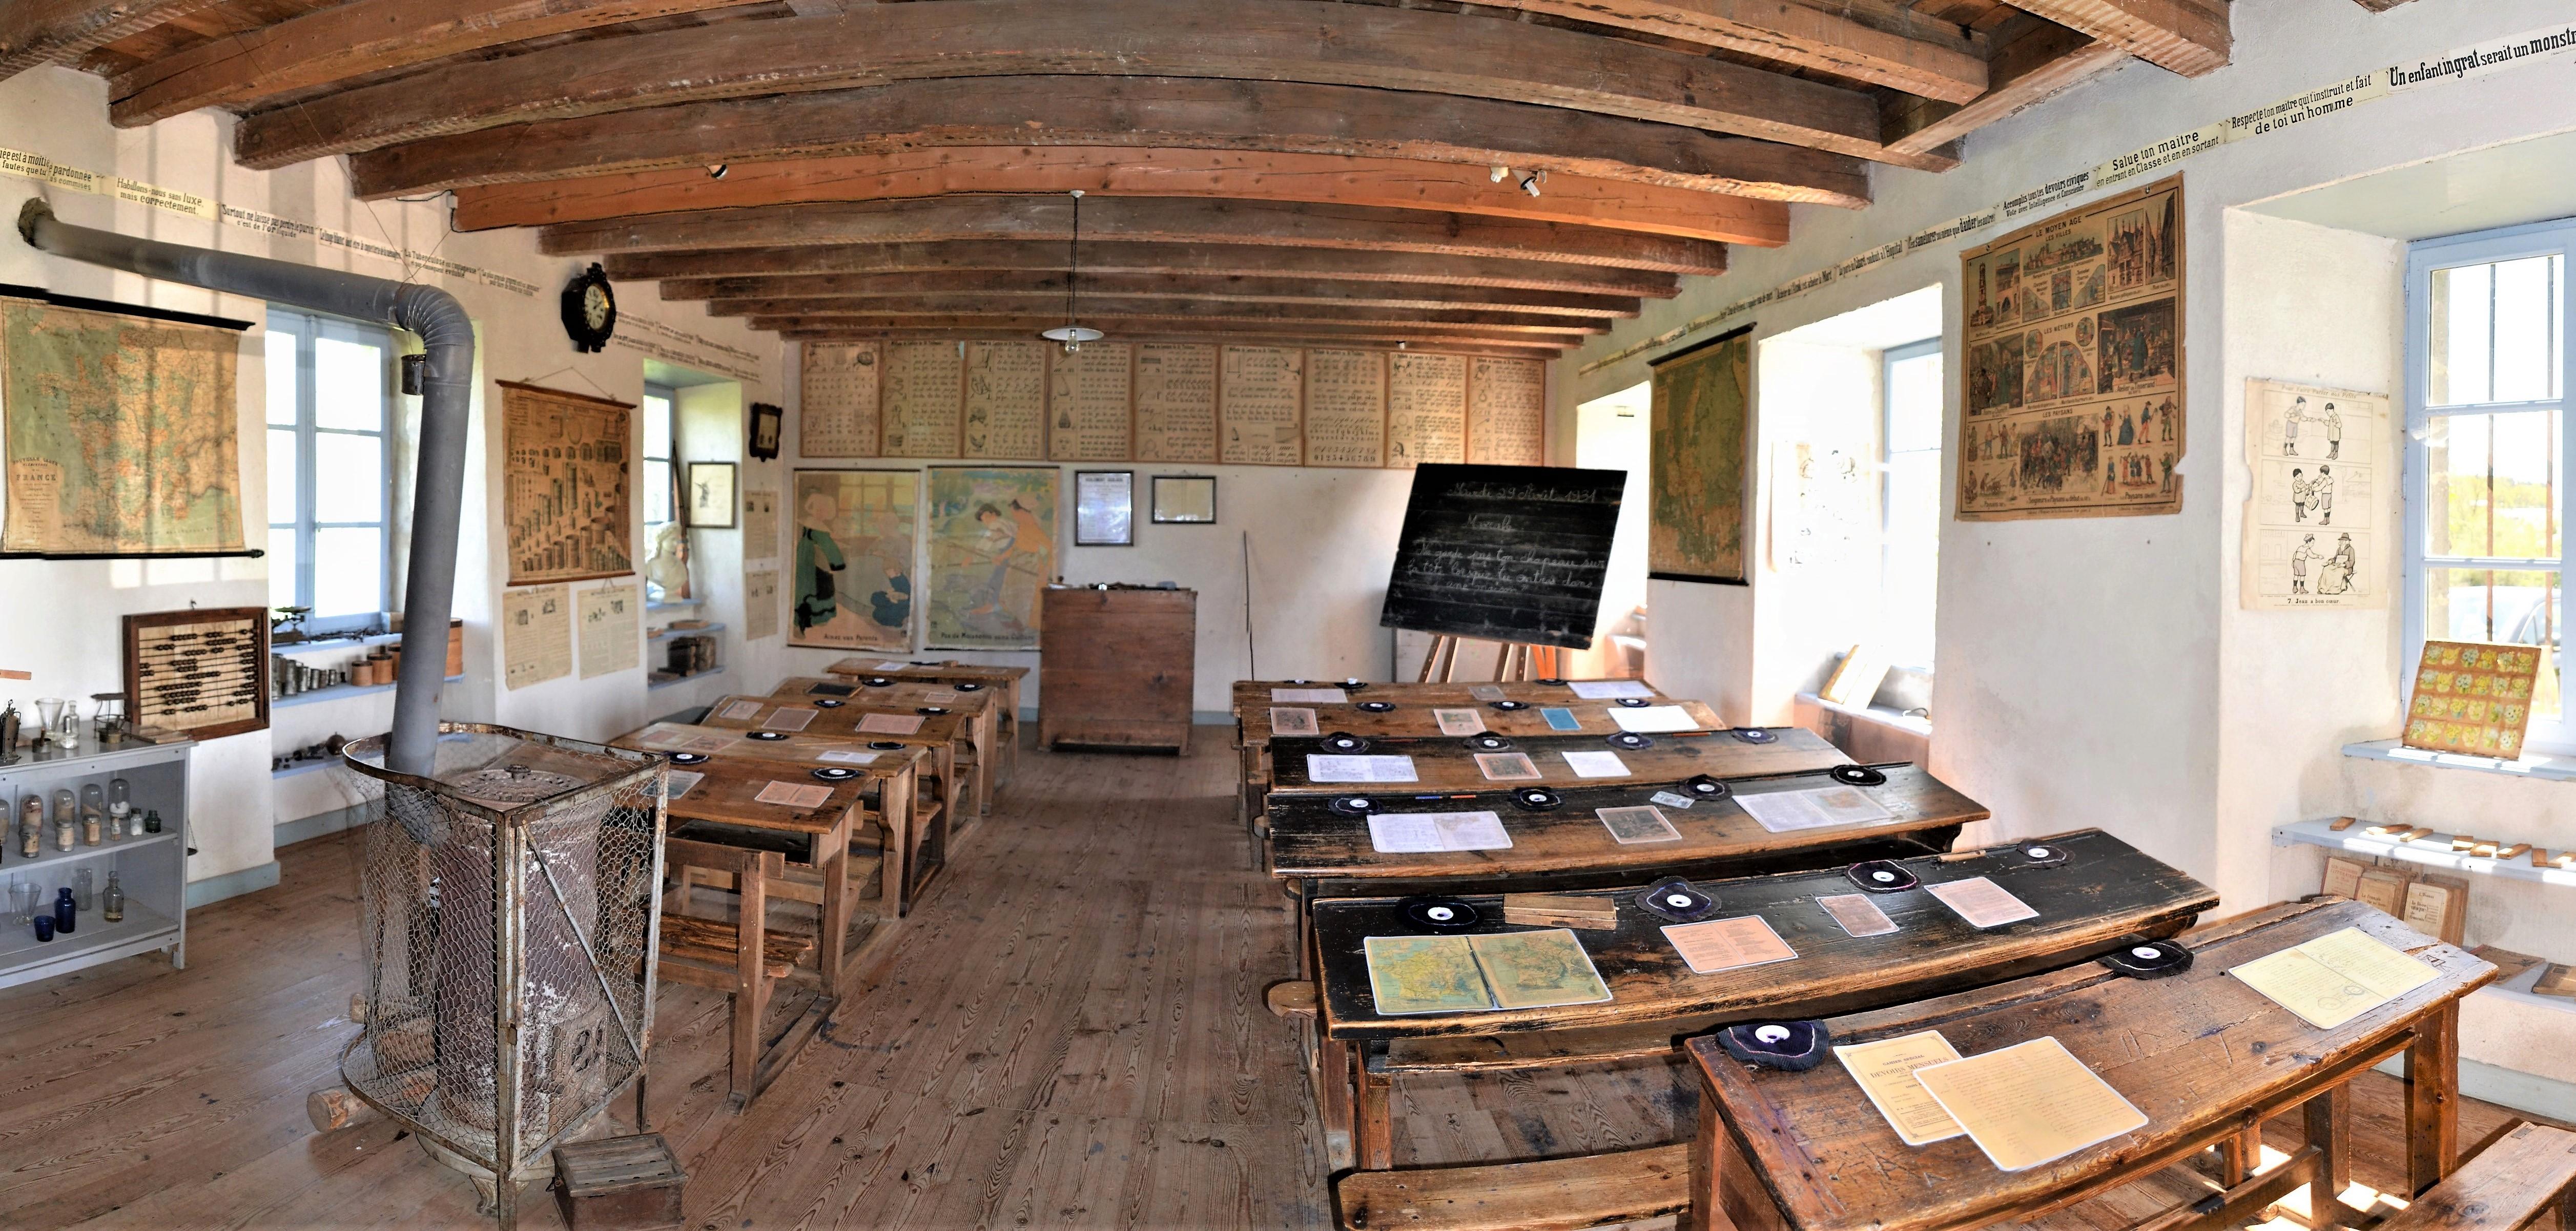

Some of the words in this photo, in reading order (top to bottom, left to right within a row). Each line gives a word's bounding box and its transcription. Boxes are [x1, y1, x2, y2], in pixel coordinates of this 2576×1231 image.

[2390, 67, 2406, 86] Un
[2408, 61, 2443, 82] enfant
[2442, 49, 2481, 78] ingrat
[2481, 45, 2512, 66] serait
[2513, 45, 2529, 57] un
[2232, 109, 2263, 129] Respecte
[2264, 107, 2275, 117] ton
[2299, 94, 2310, 110] qui
[2346, 80, 2354, 92] et
[2355, 74, 2372, 90] fait
[2255, 121, 2270, 135] de
[2273, 114, 2288, 129] toi
[2291, 111, 2305, 123] un
[11, 151, 21, 161] est
[2097, 178, 2104, 187] en
[2106, 170, 2127, 184] entrant
[2128, 167, 2136, 176] en
[2136, 157, 2161, 173] Classe
[2163, 154, 2171, 163] et
[2172, 151, 2181, 160] en
[2182, 147, 2191, 157] en
[2192, 136, 2219, 153] sortant
[2113, 153, 2138, 171] Salue
[2141, 147, 2155, 159] ton
[3, 160, 24, 171] fautes
[26, 167, 38, 175] que
[59, 179, 91, 190] commises
[2045, 179, 2066, 194] devoirs
[2066, 172, 2089, 187] civiques
[120, 191, 137, 201] mais
[169, 192, 181, 200] sans
[222, 204, 245, 219] Surtout
[2045, 221, 2066, 234] MOYEN
[2069, 216, 2082, 225] AGE
[2055, 228, 2071, 238] VILLES
[1870, 1067, 1906, 1078] DEVOIRS
[1907, 1057, 1949, 1070] MENSUELS
